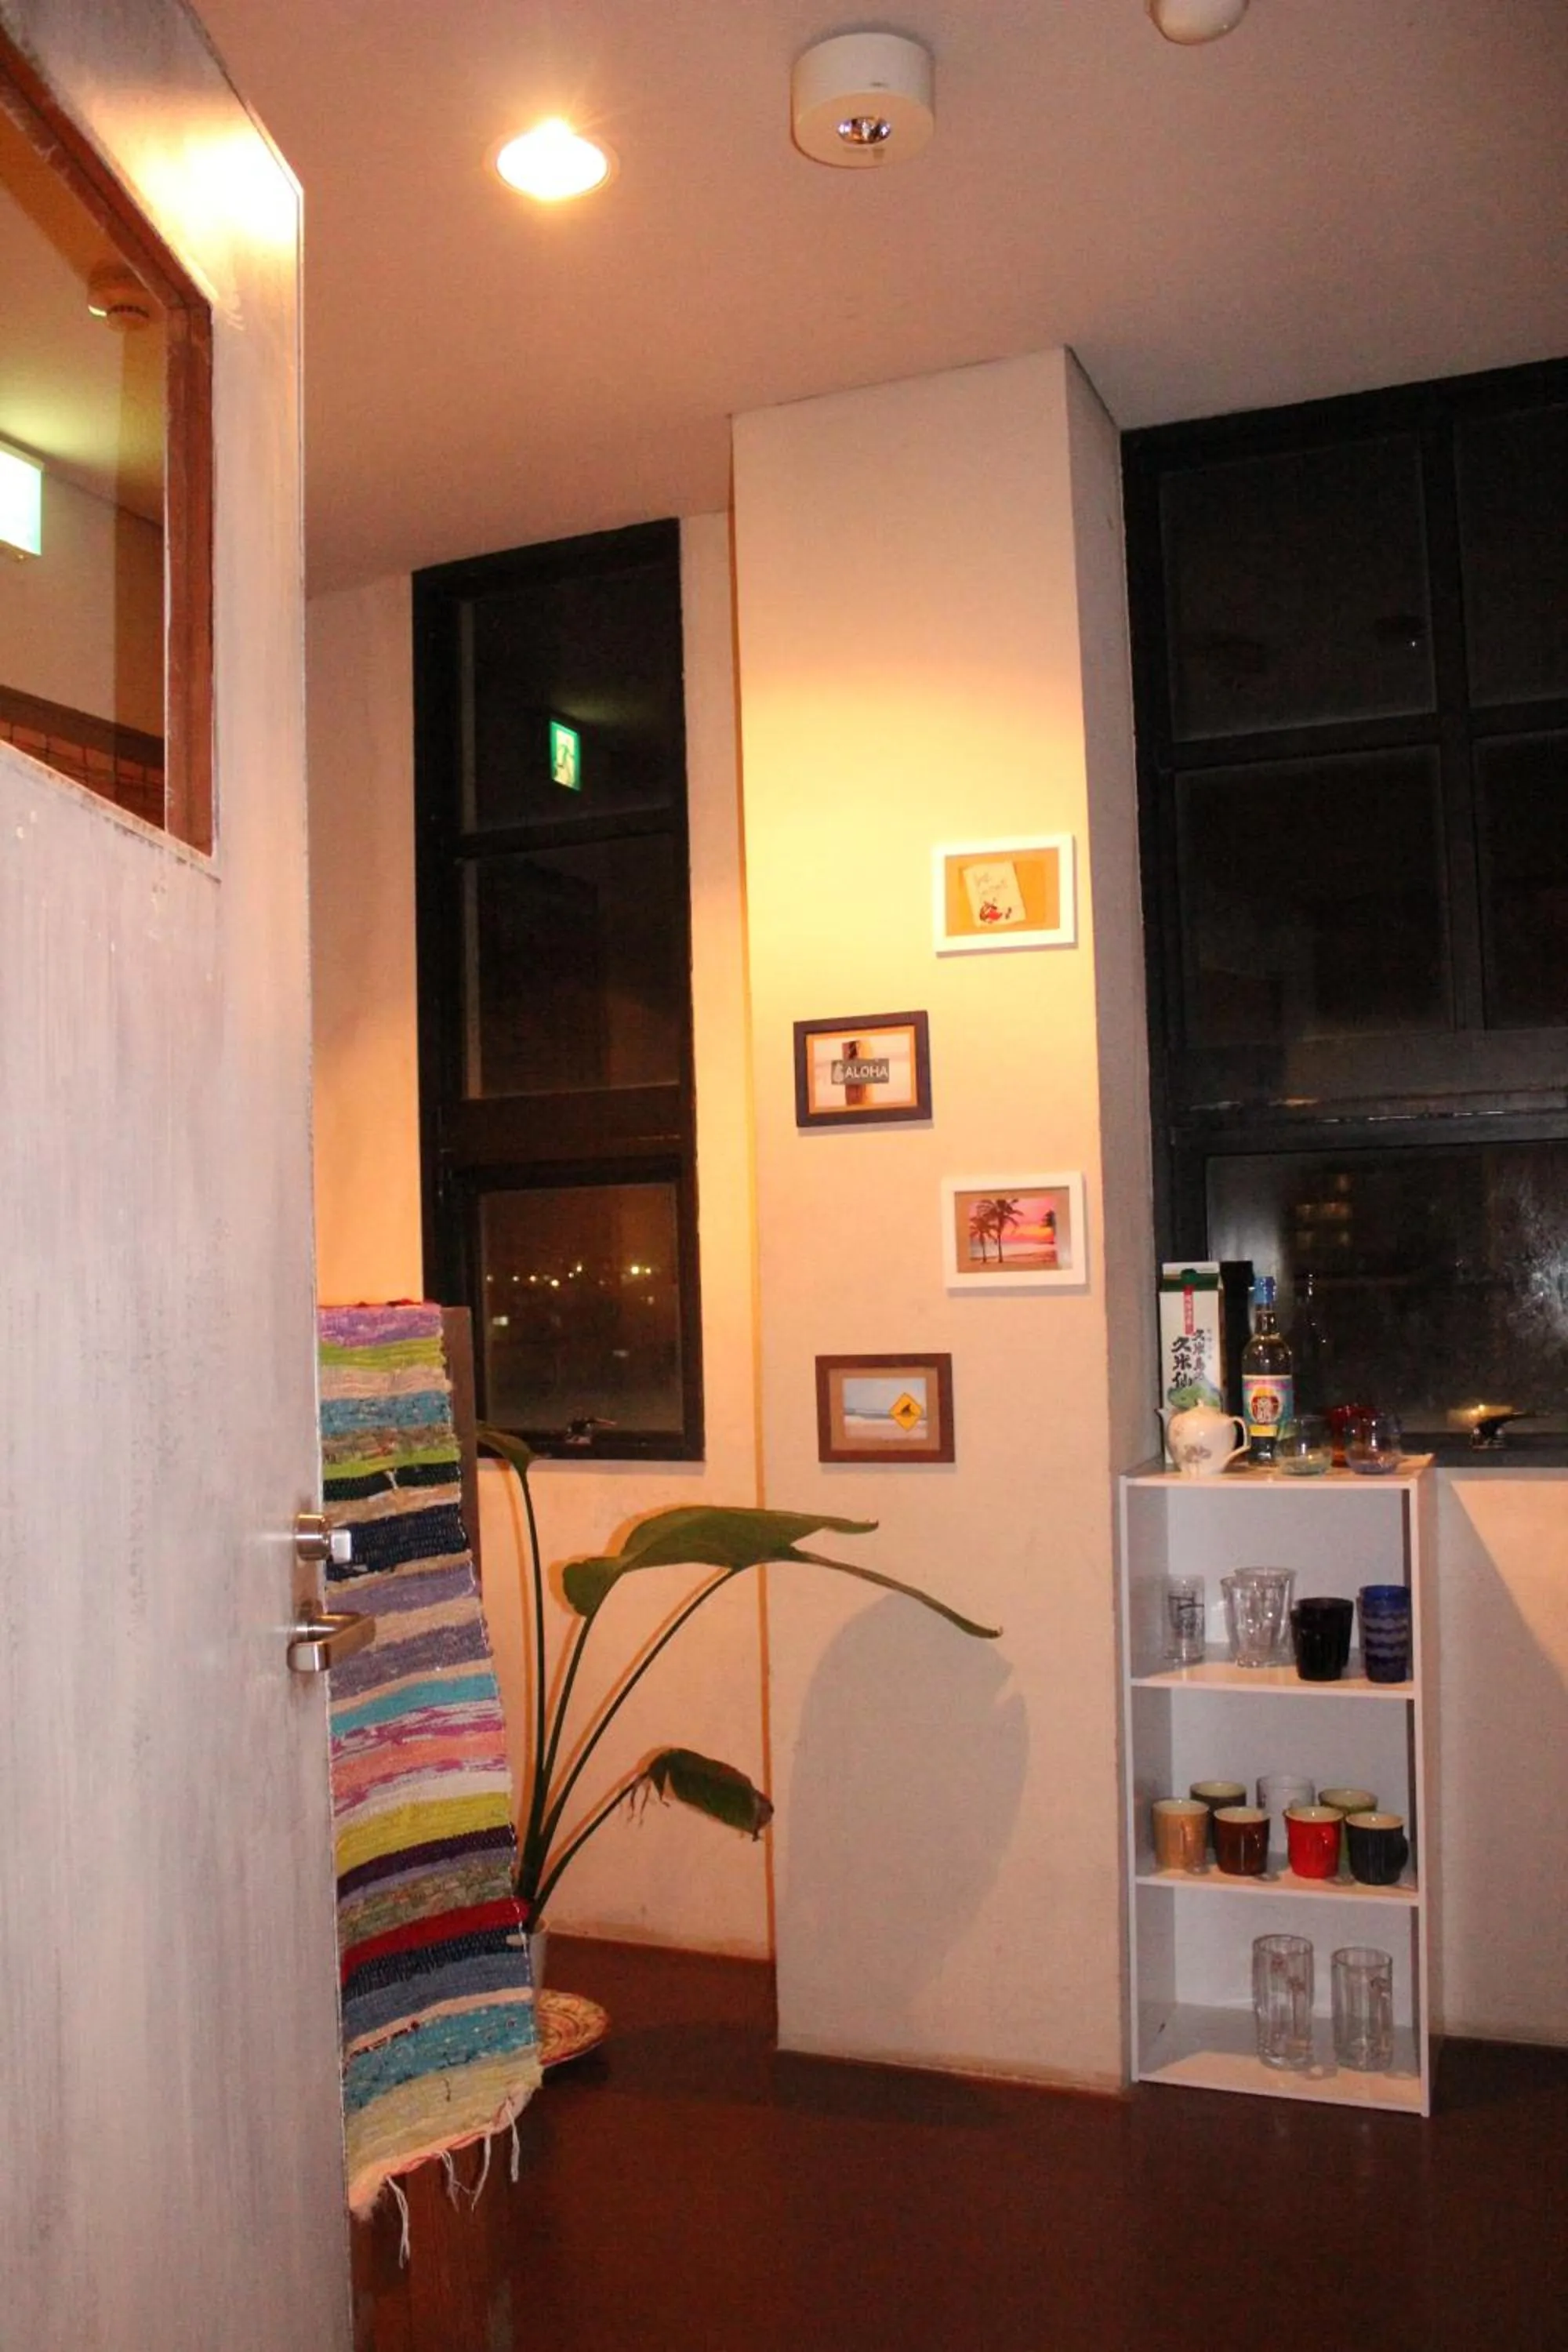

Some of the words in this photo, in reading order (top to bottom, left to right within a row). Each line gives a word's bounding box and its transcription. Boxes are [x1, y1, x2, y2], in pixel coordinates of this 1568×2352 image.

[845, 1065, 888, 1079] ALOHA
[1171, 1336, 1192, 1388] 久米仙
